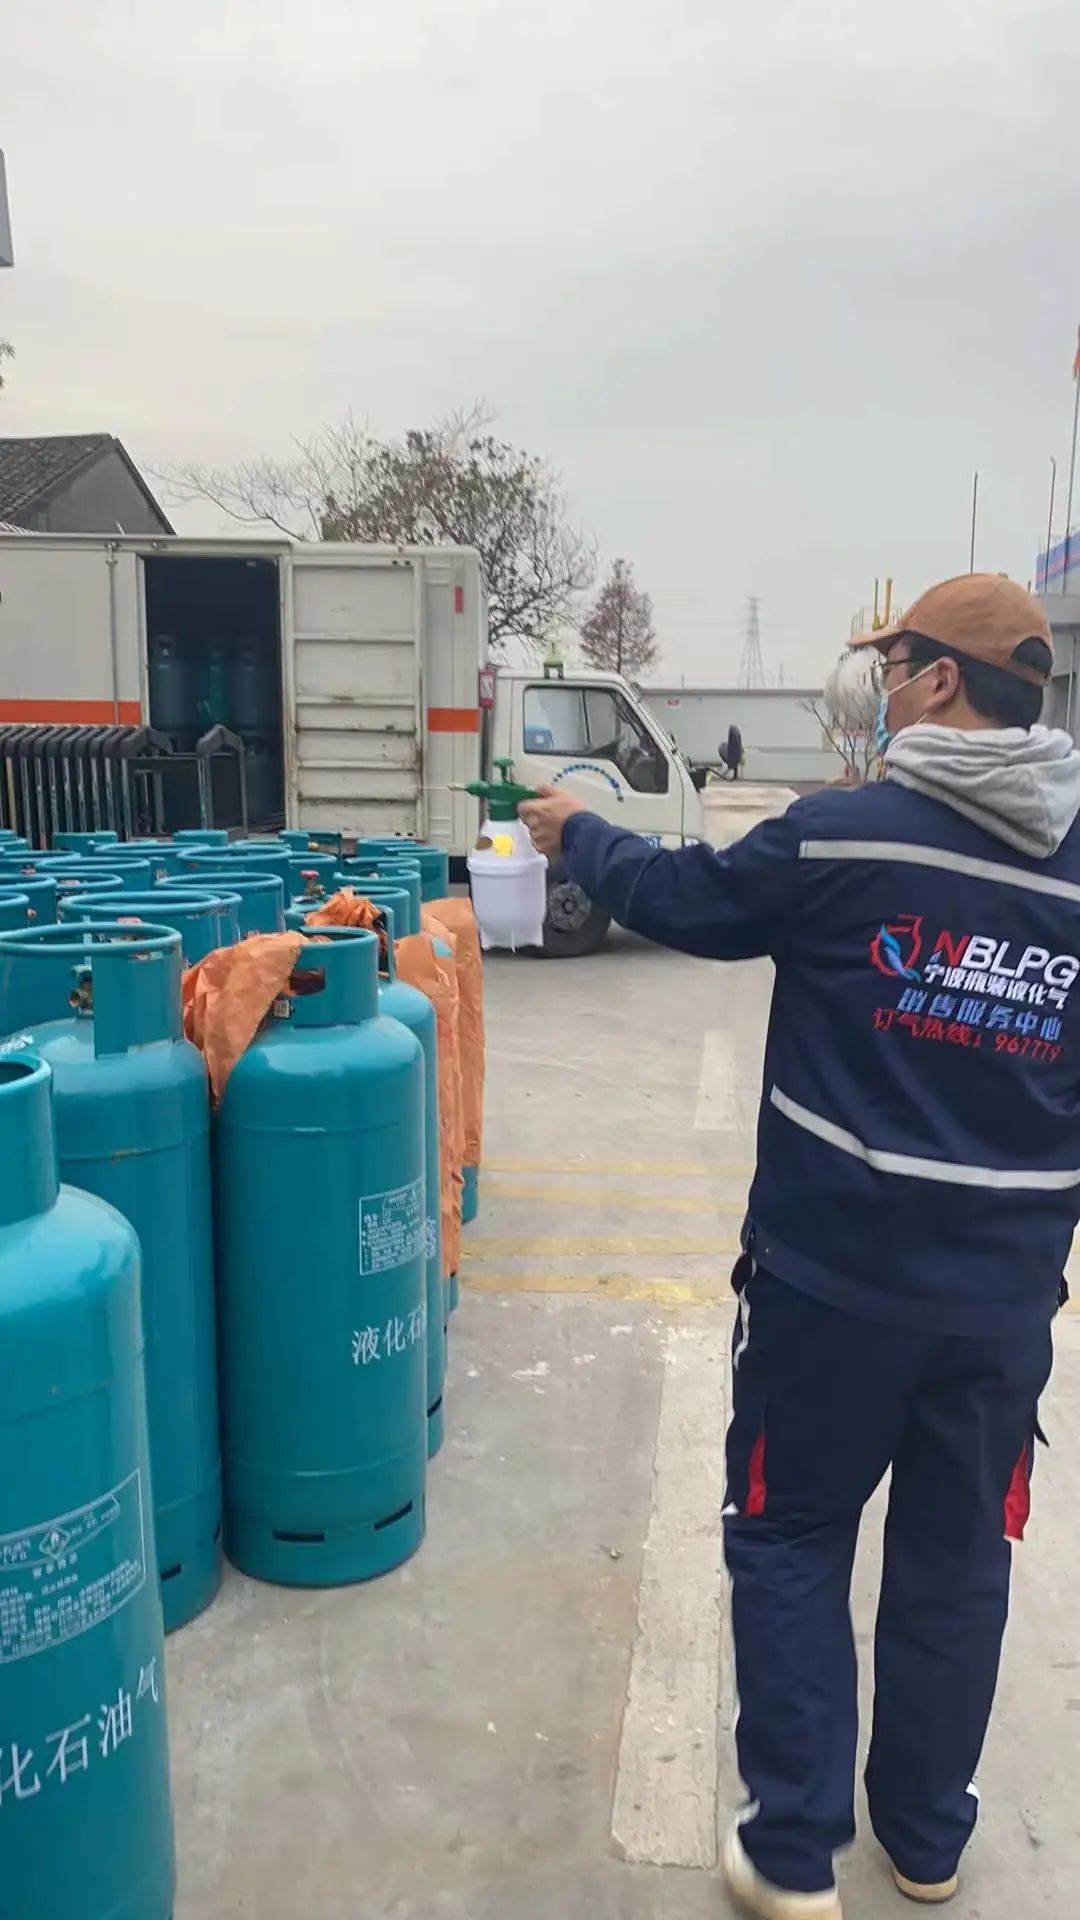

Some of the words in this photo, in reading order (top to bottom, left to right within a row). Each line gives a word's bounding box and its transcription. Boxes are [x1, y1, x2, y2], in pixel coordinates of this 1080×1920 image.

[929, 930, 1080, 989] NBLPG
[896, 987, 1063, 1041] 销售服务中心
